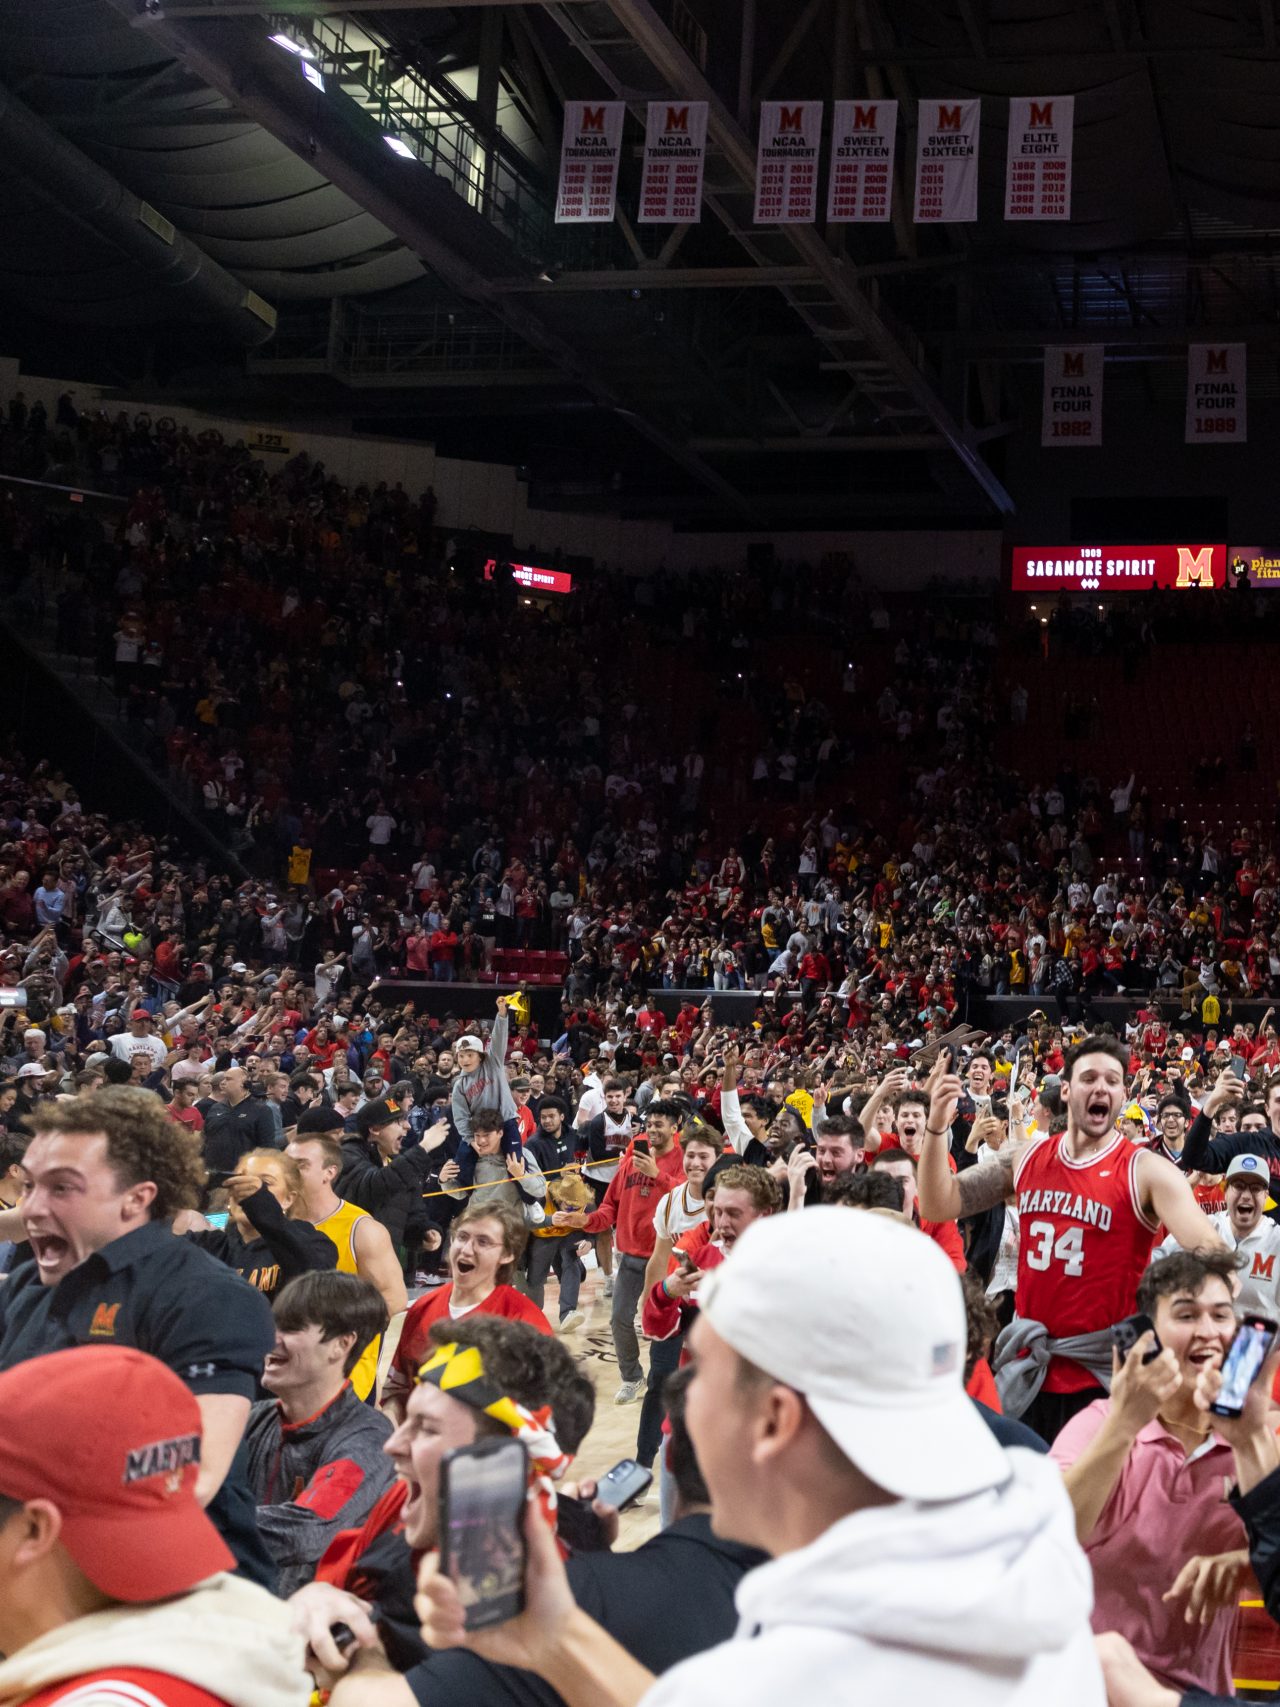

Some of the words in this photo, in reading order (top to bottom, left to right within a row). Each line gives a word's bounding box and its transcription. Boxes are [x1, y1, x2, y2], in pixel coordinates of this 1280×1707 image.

[581, 107, 606, 133] M
[664, 107, 688, 134] M
[779, 107, 803, 134] M
[853, 106, 877, 133] M
[937, 105, 963, 132] M
[1029, 102, 1053, 129] M
[575, 137, 607, 146] NCAA
[658, 137, 691, 146] NCAA
[772, 137, 805, 146] NCAA
[844, 137, 884, 145] SWEET
[928, 136, 969, 145] SWEET
[1023, 133, 1058, 142] ELITE
[565, 148, 616, 157] TOURNAMENT
[648, 148, 702, 157] TOURNAMENT
[762, 148, 815, 157] TOURNAMENT
[837, 148, 888, 156] SIXTEEN
[923, 146, 973, 156] SIXTEEN
[1022, 144, 1059, 153] EIGHT
[920, 187, 943, 195] 2017
[1063, 353, 1084, 377] M
[1206, 350, 1228, 374] M
[1051, 386, 1093, 398] FINAL
[1195, 383, 1237, 395] FINAL
[1053, 400, 1091, 412] FOUR
[1197, 398, 1235, 409] FOUR
[1027, 560, 1102, 576] SAGAMORE
[1106, 559, 1155, 576] SPIRIT
[1176, 548, 1214, 587] M
[533, 573, 554, 584] SPIRIT
[1018, 1190, 1112, 1232] MARYLAND
[1027, 1221, 1085, 1276] 34
[1249, 1252, 1275, 1281] M
[89, 1302, 121, 1336] M
